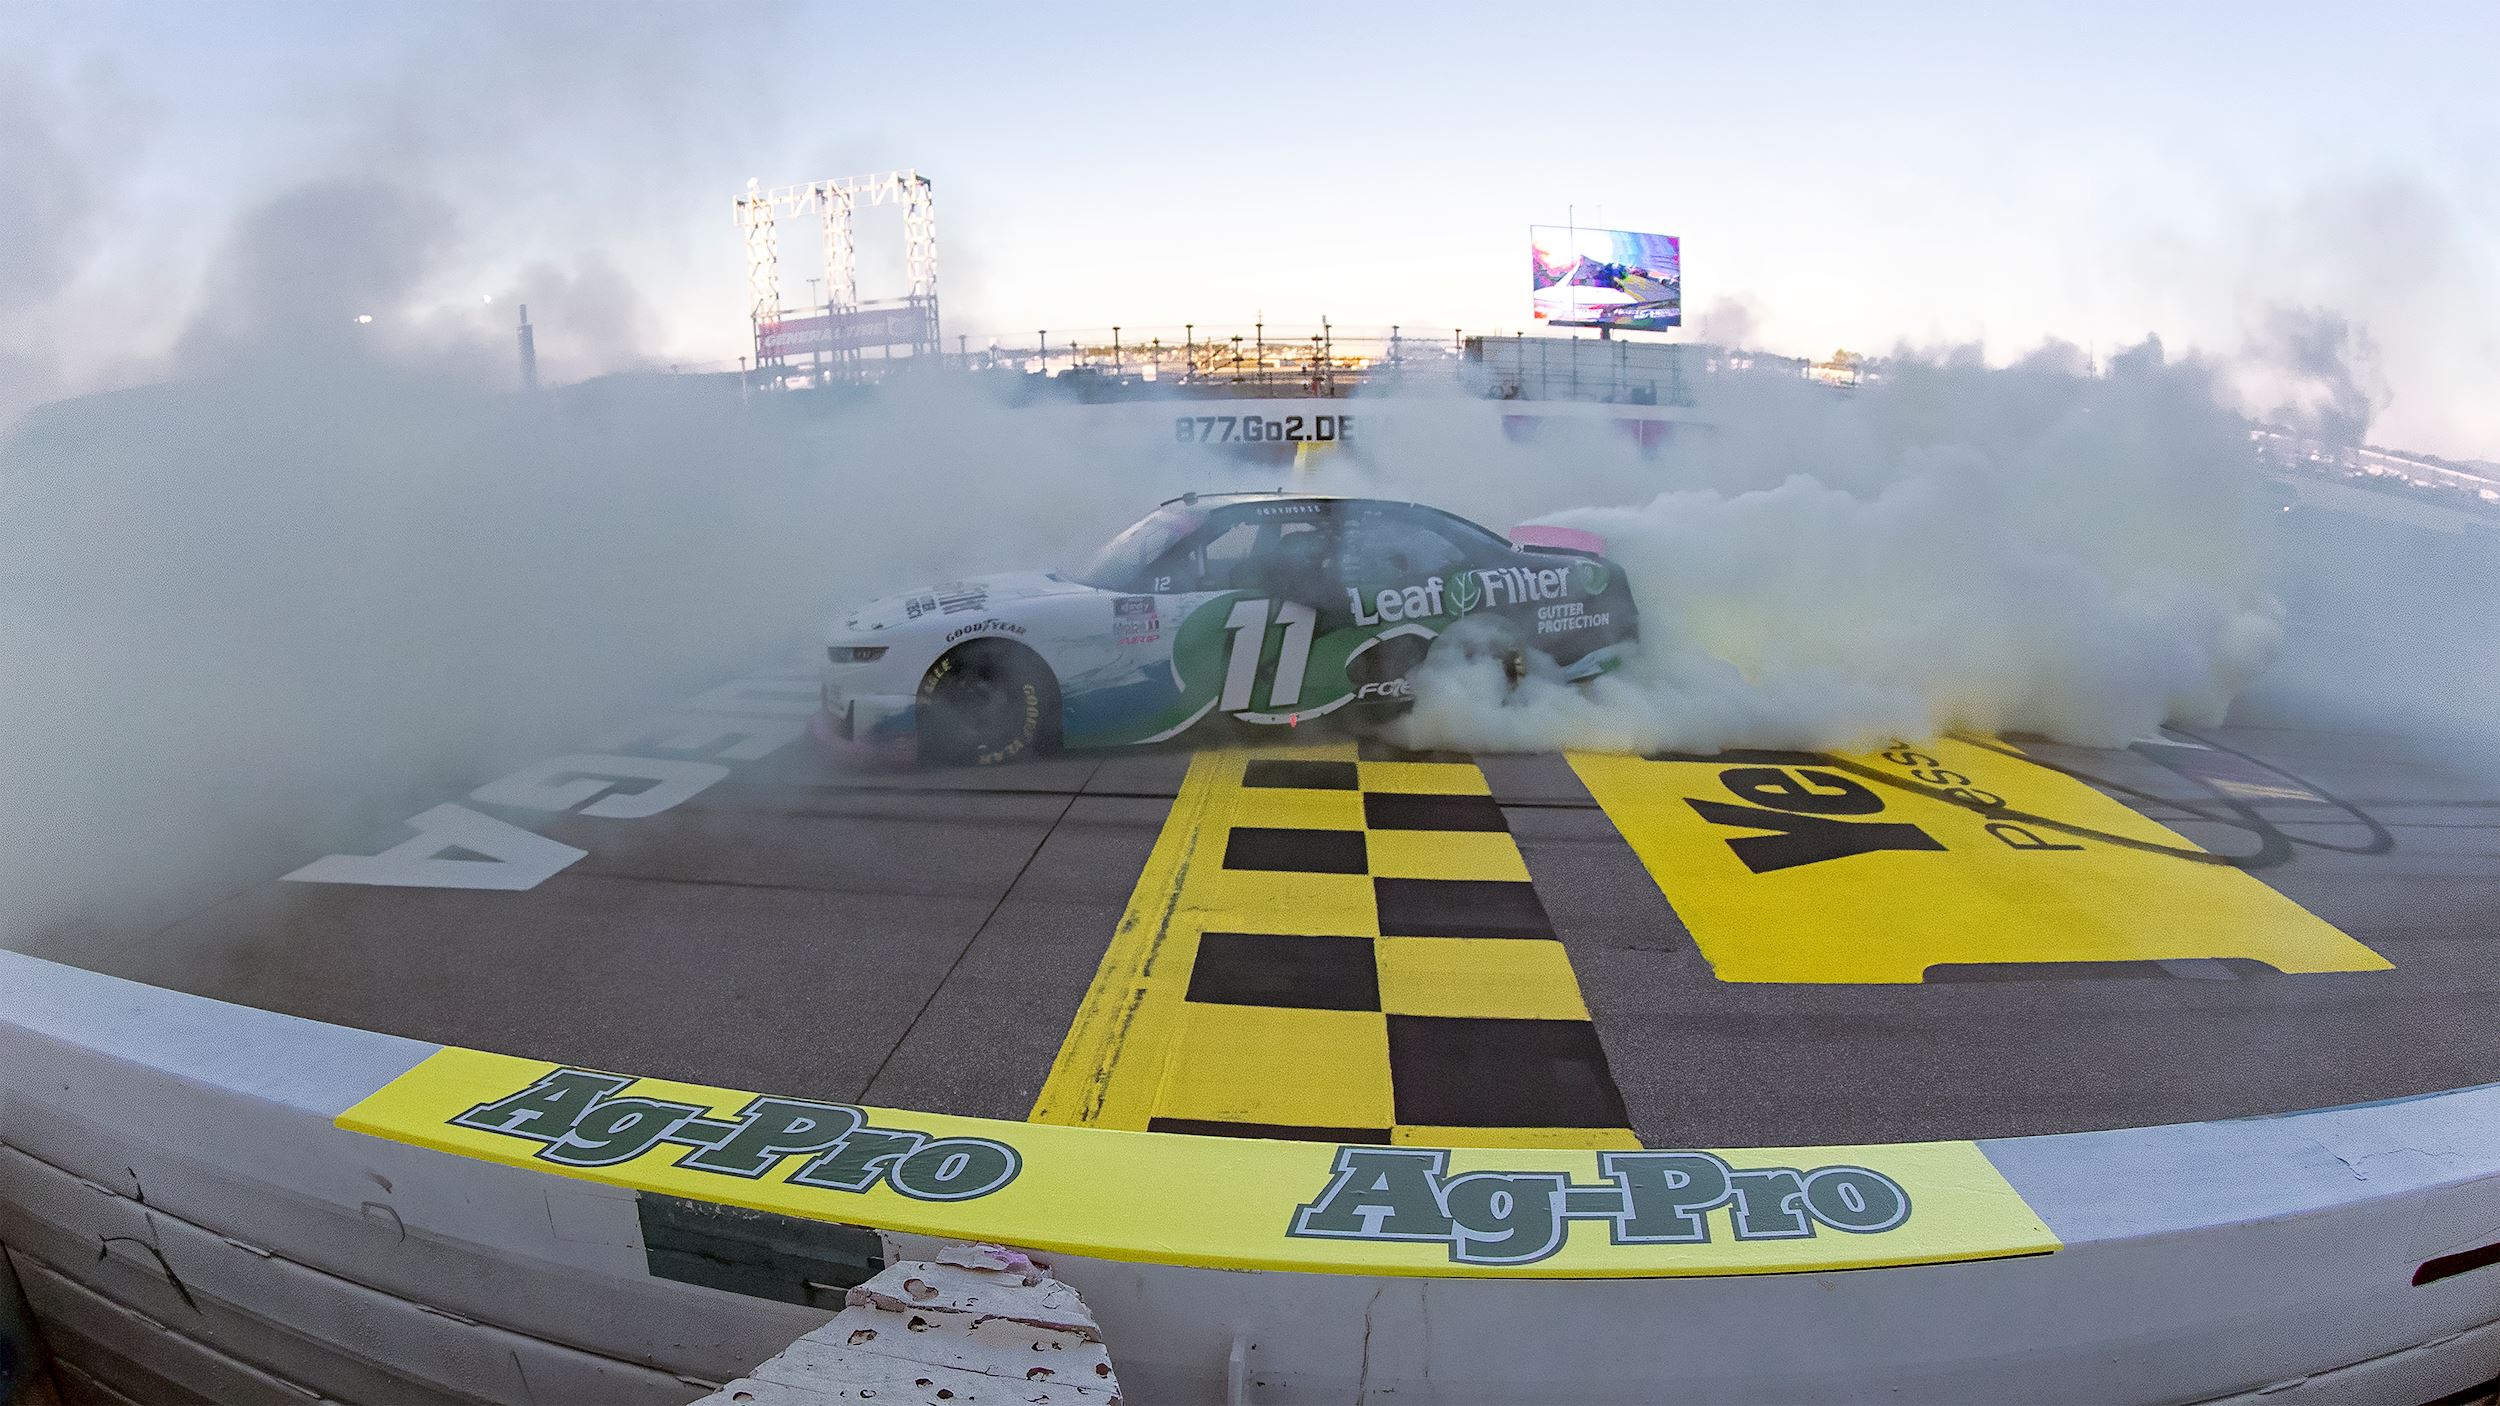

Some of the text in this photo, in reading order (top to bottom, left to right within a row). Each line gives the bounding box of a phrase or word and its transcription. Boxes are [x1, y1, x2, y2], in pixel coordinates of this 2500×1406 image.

[1154, 575, 1171, 592] 12
[1347, 566, 1570, 626] Leaf Filter
[1537, 602, 1584, 620] GUTTER
[945, 618, 1027, 643] GOODYEAR
[1537, 613, 1609, 634] PROTECTION
[1219, 599, 1317, 712] 11
[1880, 740, 2087, 851] Press
[448, 1066, 1023, 1203] Ag-Pro
[1285, 1146, 1912, 1263] Ag-Pro
